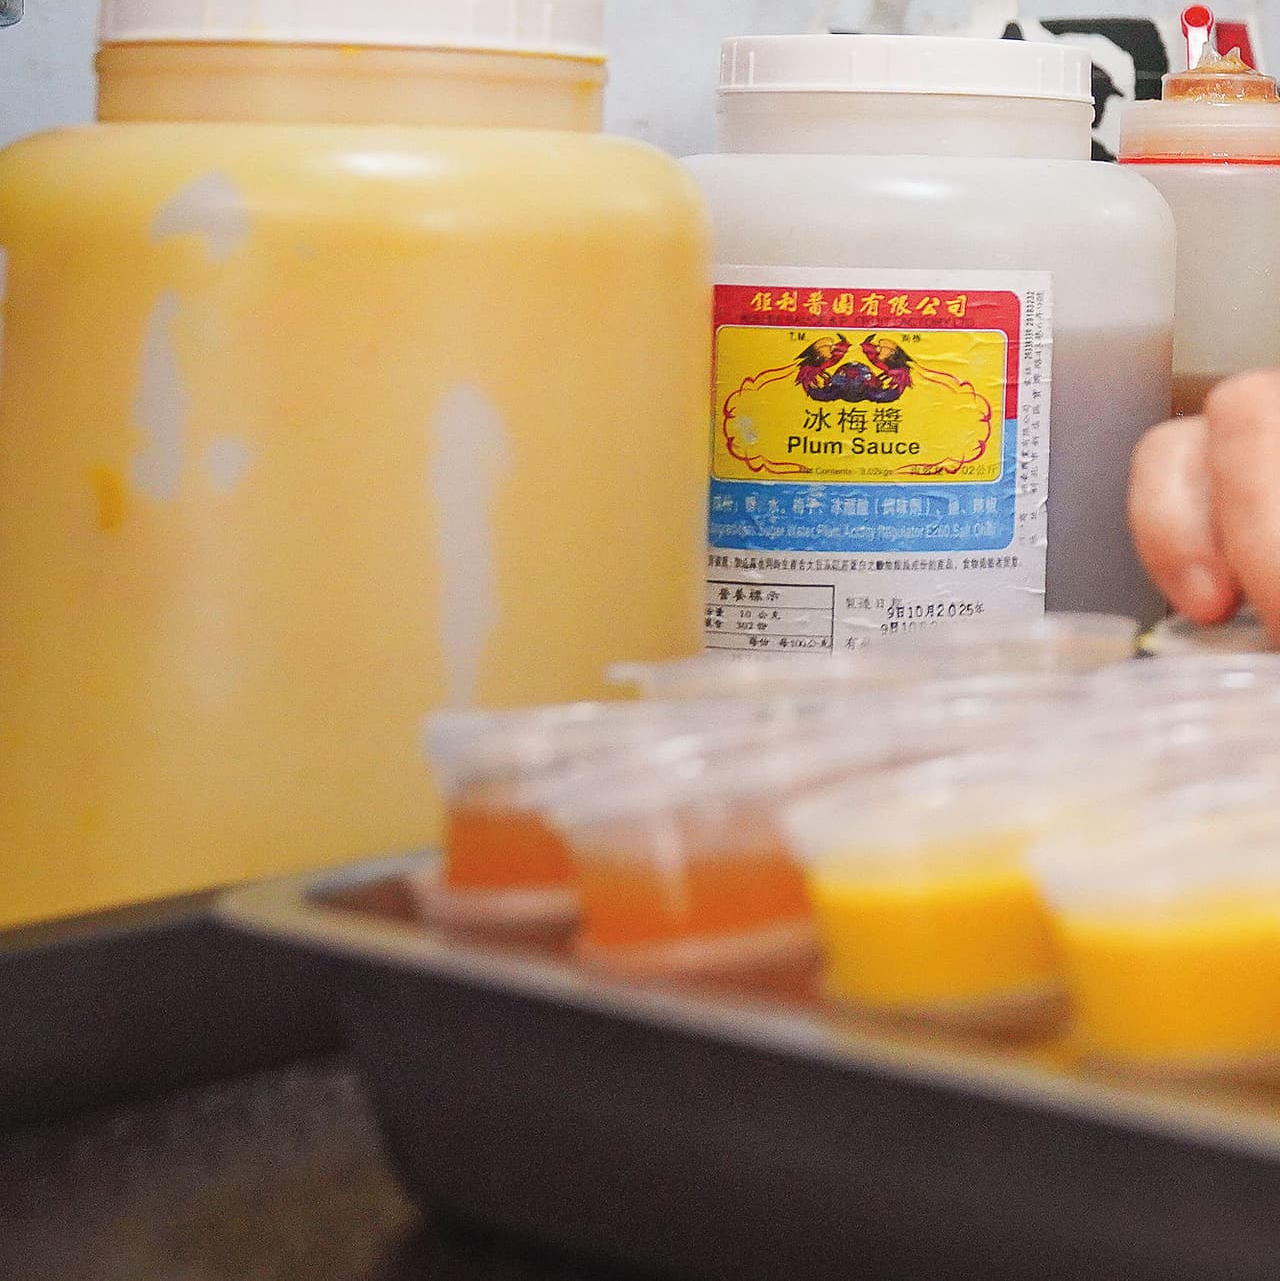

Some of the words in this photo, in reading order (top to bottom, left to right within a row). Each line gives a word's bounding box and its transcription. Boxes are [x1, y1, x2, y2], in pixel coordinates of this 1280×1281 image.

[802, 407, 902, 434] 冰梅醬
[787, 437, 842, 455] Plum
[852, 437, 920, 455] Sauce
